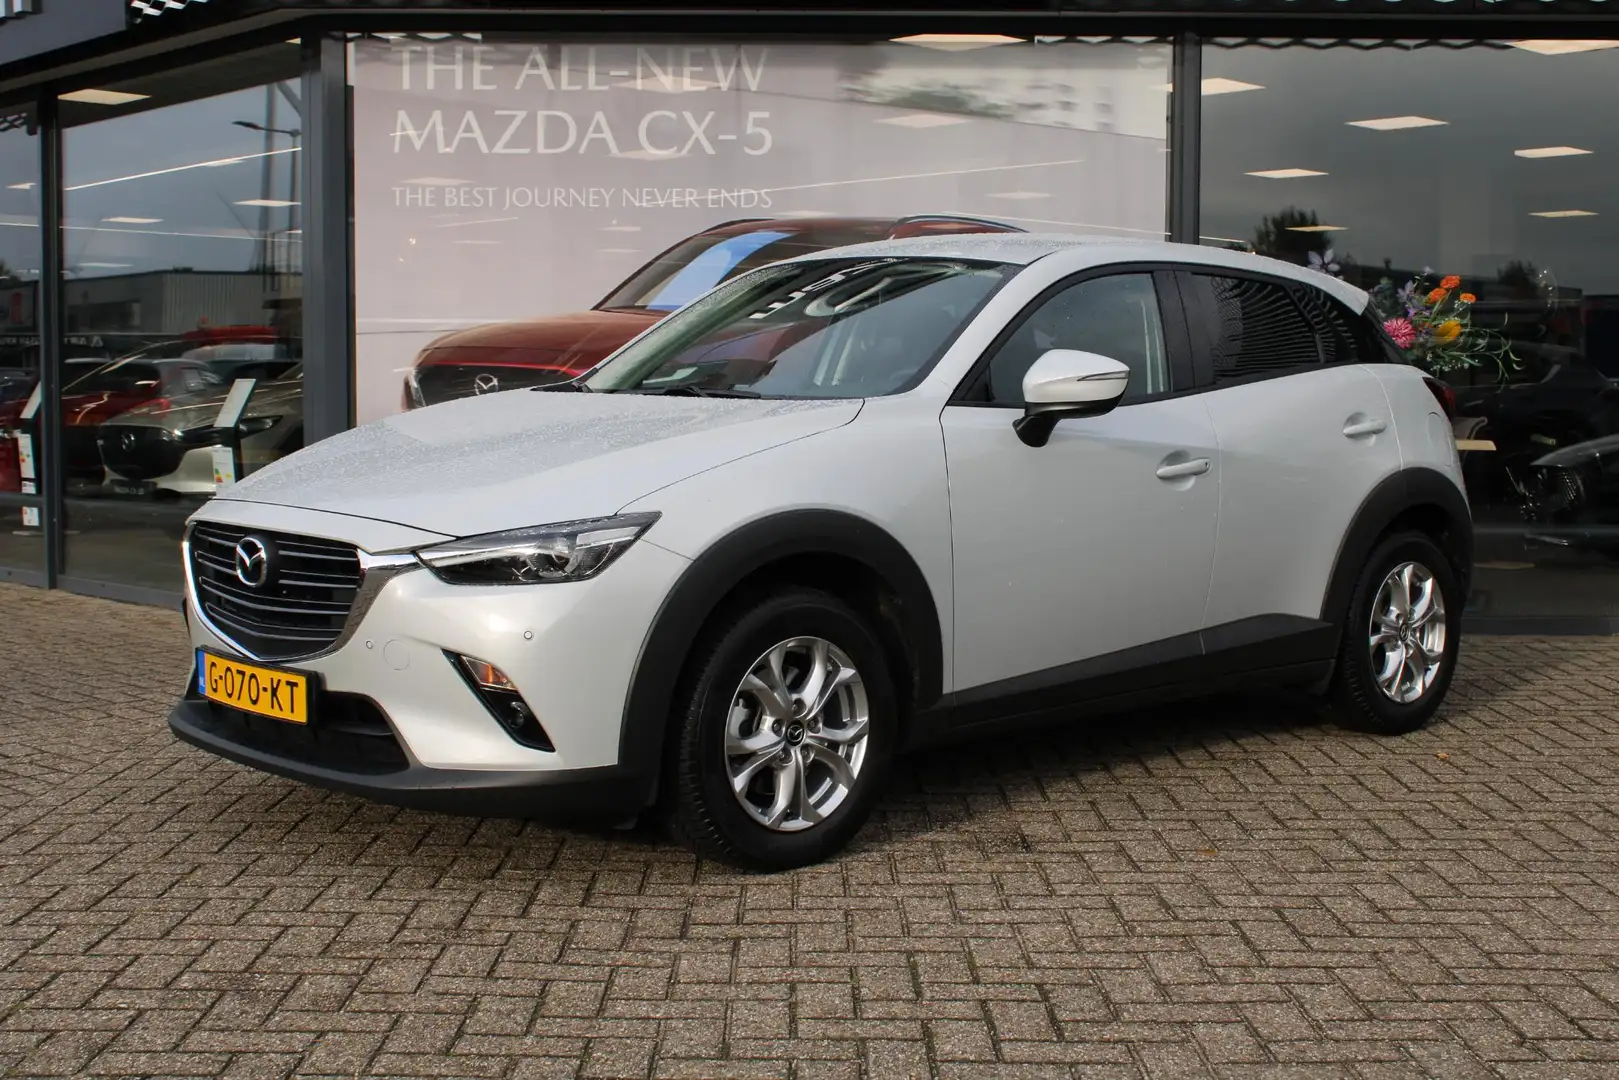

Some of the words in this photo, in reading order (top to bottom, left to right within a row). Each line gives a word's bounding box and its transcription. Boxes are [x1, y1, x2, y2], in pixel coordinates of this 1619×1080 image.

[399, 46, 498, 91] THE
[514, 45, 768, 91] ALL-NEW
[393, 109, 619, 155] MAZDA
[637, 109, 773, 156] CX-5
[391, 187, 436, 208] THE
[444, 186, 497, 208] BEST
[502, 186, 615, 211] JOURNEY
[621, 187, 700, 209] NEVER
[707, 187, 773, 209] ENDS
[209, 661, 299, 714] G-070-KT
